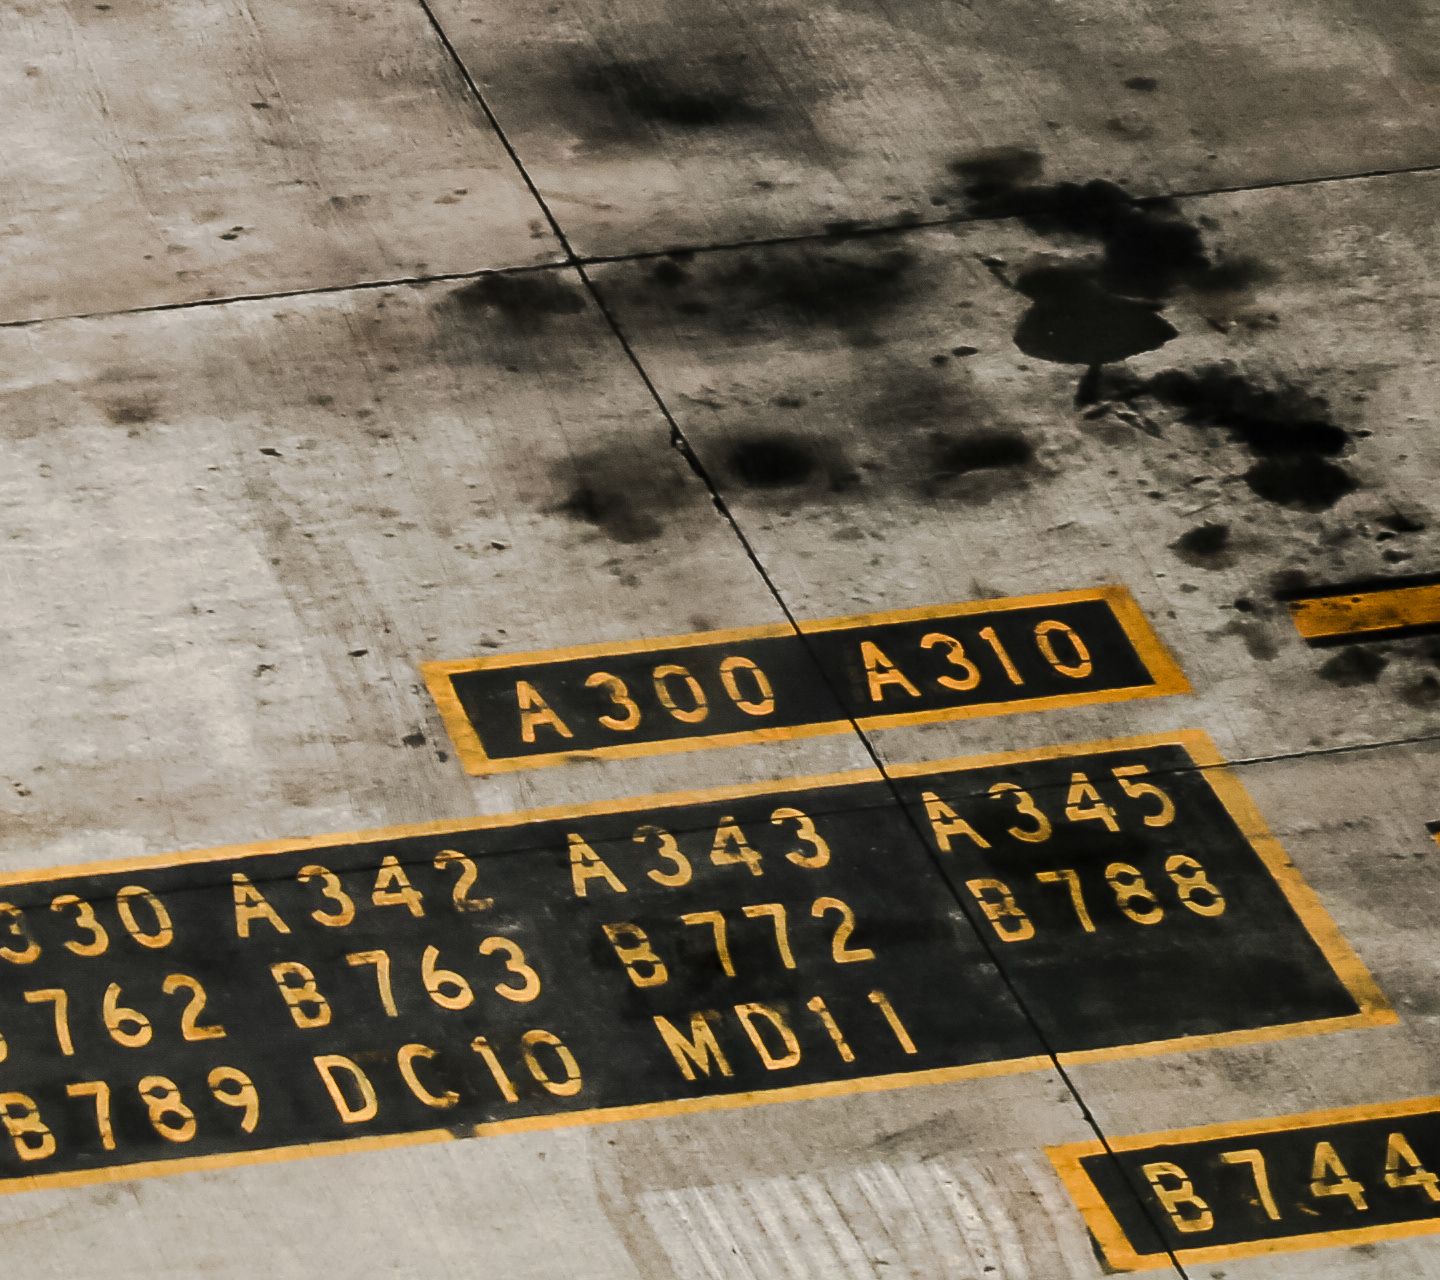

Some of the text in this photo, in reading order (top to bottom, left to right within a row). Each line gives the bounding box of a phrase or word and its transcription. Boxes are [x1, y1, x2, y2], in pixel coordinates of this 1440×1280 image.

[516, 620, 1094, 742] A300 A310
[233, 849, 493, 938] A342
[567, 806, 831, 897] A343
[921, 763, 1176, 851] A345
[270, 935, 542, 1029] B763
[603, 896, 874, 988] B772
[965, 854, 1227, 942] B788
[314, 1029, 583, 1124] DC10
[652, 988, 917, 1081] MD11
